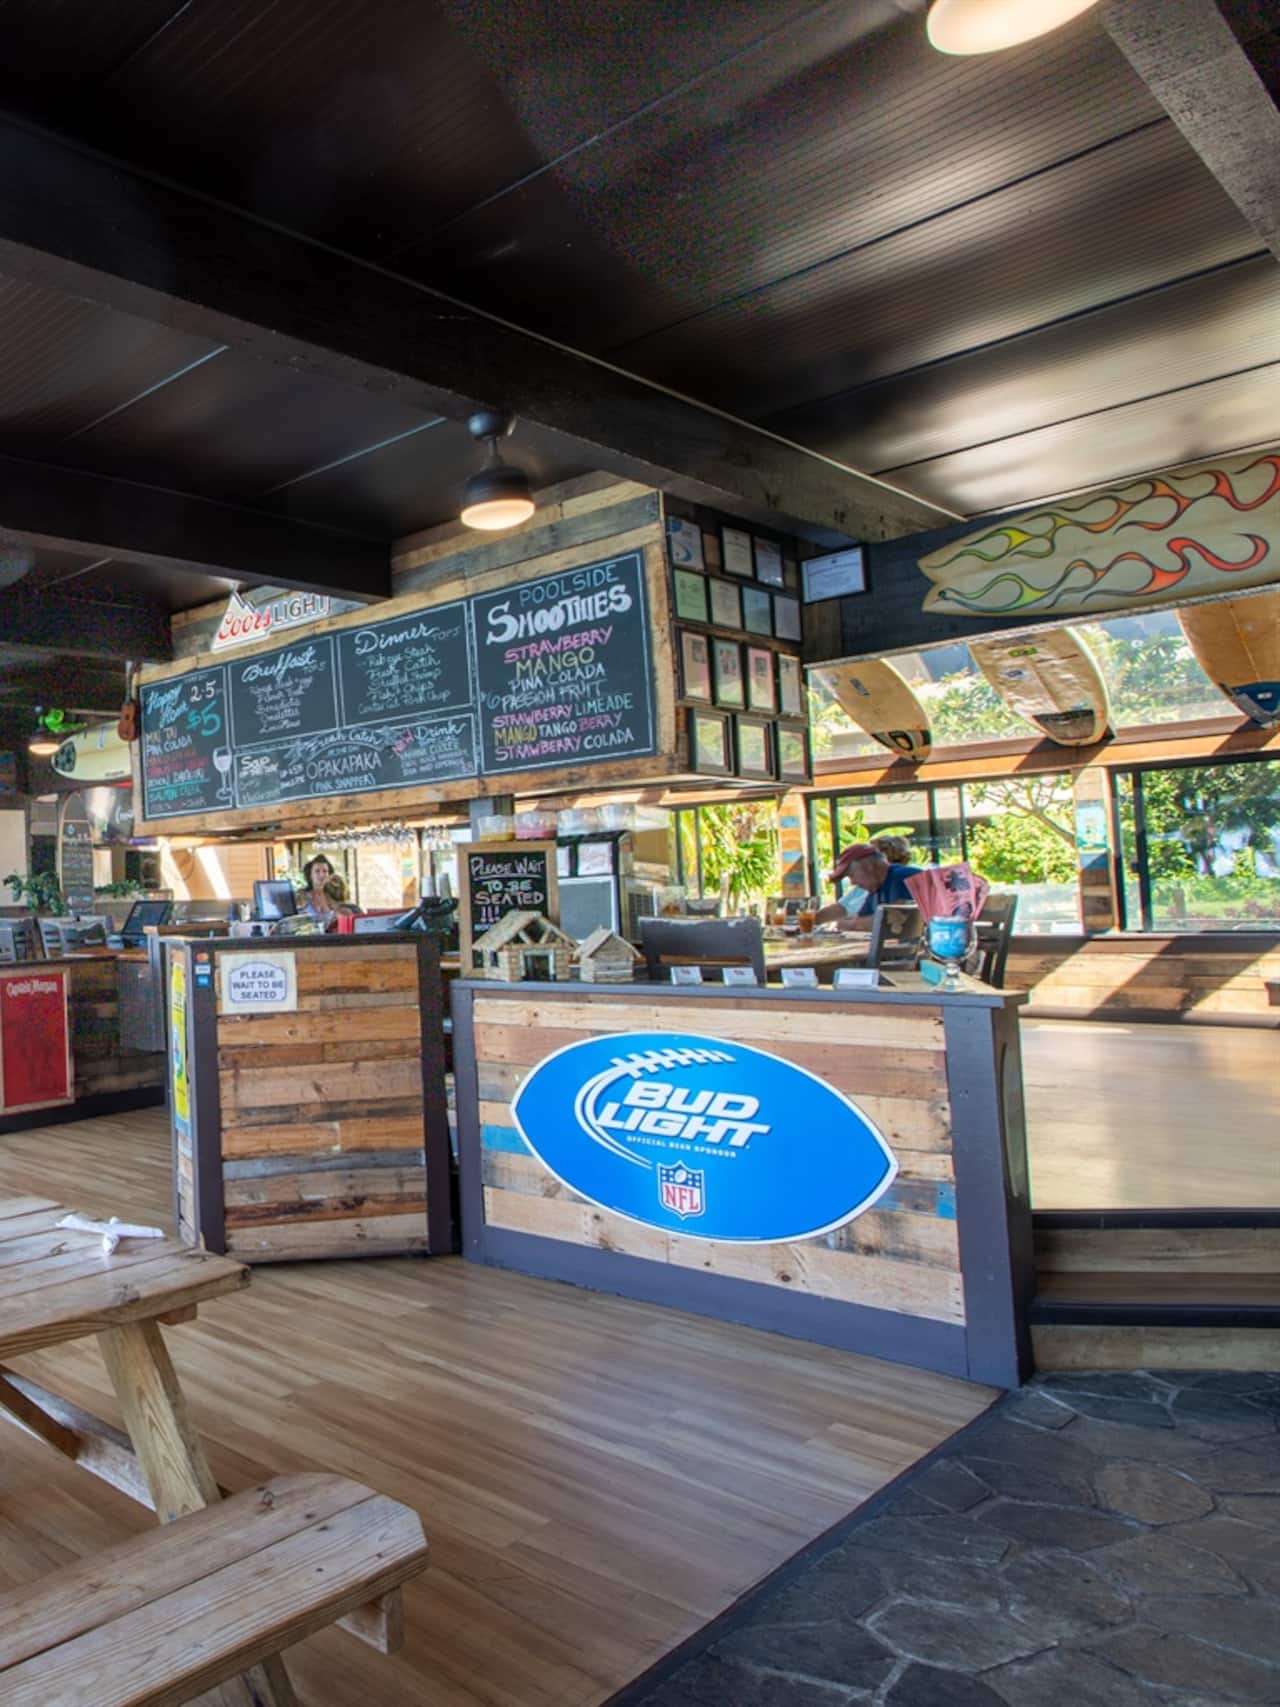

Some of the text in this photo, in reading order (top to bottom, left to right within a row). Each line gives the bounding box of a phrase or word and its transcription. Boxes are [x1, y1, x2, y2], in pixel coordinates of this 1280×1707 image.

[520, 564, 619, 607] POOLSIDE
[218, 606, 272, 640] Coors
[485, 584, 632, 645] SMOOTHIES
[354, 622, 440, 655] Dinner
[504, 625, 613, 664] STRAWBERRY
[508, 662, 606, 692] PINA COLADA
[516, 647, 595, 680] MANGO
[147, 683, 183, 714] Happy
[491, 692, 634, 728] STRAWBERRY LIMEADE
[501, 689, 556, 713] PASSION
[559, 679, 608, 702] FRUIT
[186, 700, 221, 736] $5
[494, 712, 622, 747] MANGO TANGO BERRY
[495, 736, 582, 762] STRAWBERRY
[583, 728, 634, 749] COLADA
[306, 751, 382, 780] OPAKAPAKA
[470, 856, 544, 876] PLEASE WAIT
[474, 891, 544, 905] SEATED
[482, 879, 533, 892] TO BE
[232, 980, 283, 990] WAIT TO BE
[240, 970, 275, 980] PLEASE
[241, 991, 277, 1000] SEATED
[623, 1080, 759, 1120] BUD
[596, 1102, 771, 1147] LIGHT
[627, 1135, 736, 1158] OFFICIAL BEER SPONSOR
[664, 1184, 699, 1211] NFL
